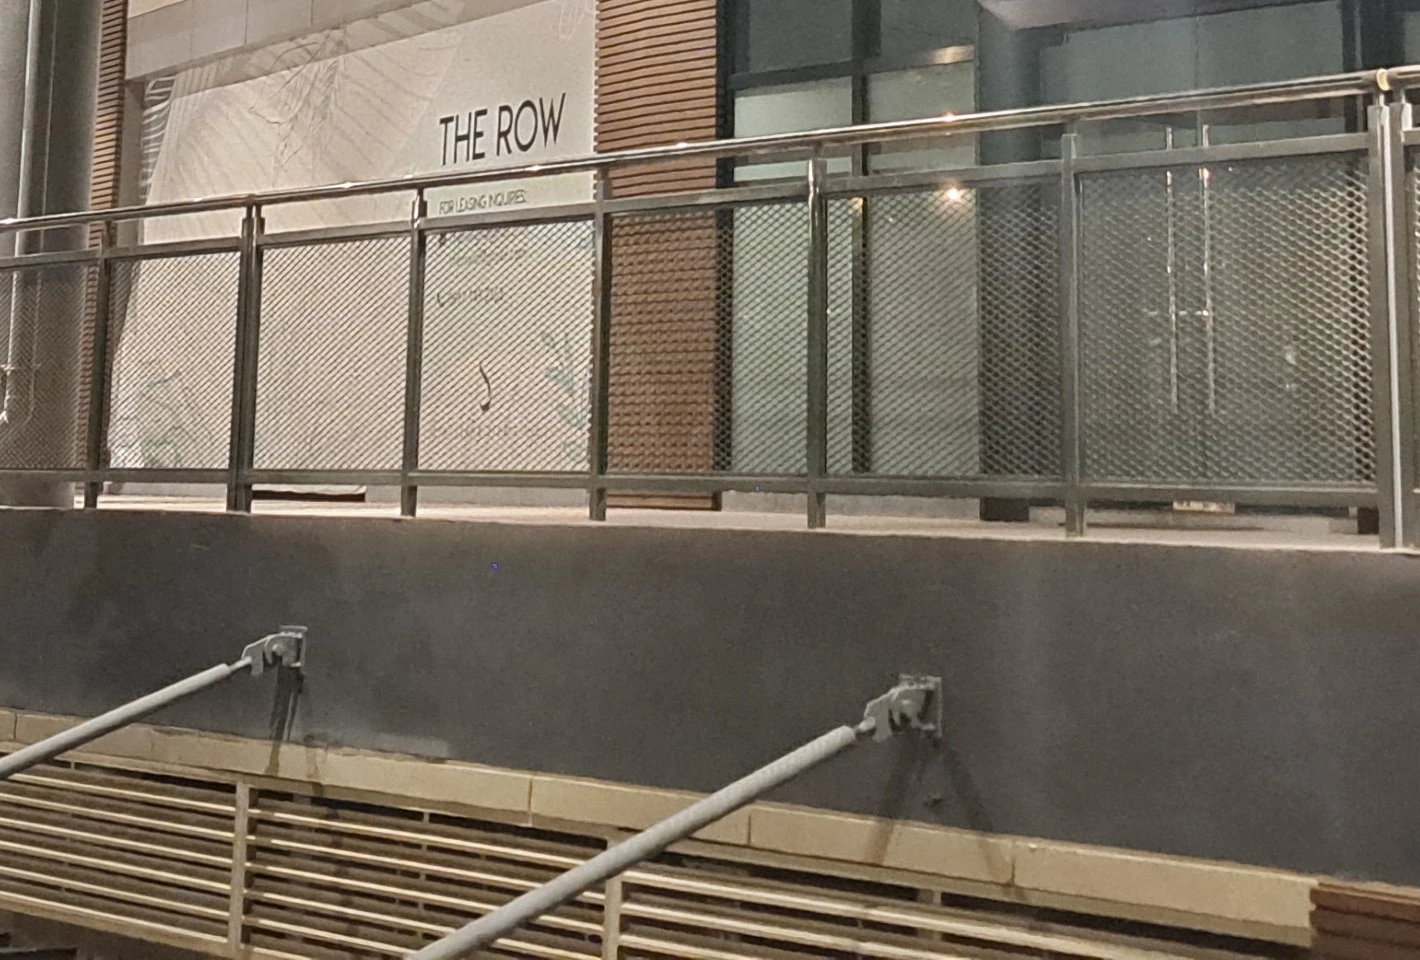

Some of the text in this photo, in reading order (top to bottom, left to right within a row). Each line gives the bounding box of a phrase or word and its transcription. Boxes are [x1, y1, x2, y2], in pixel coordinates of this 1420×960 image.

[439, 92, 566, 166] THE ROW
[439, 200, 454, 215] FOR
